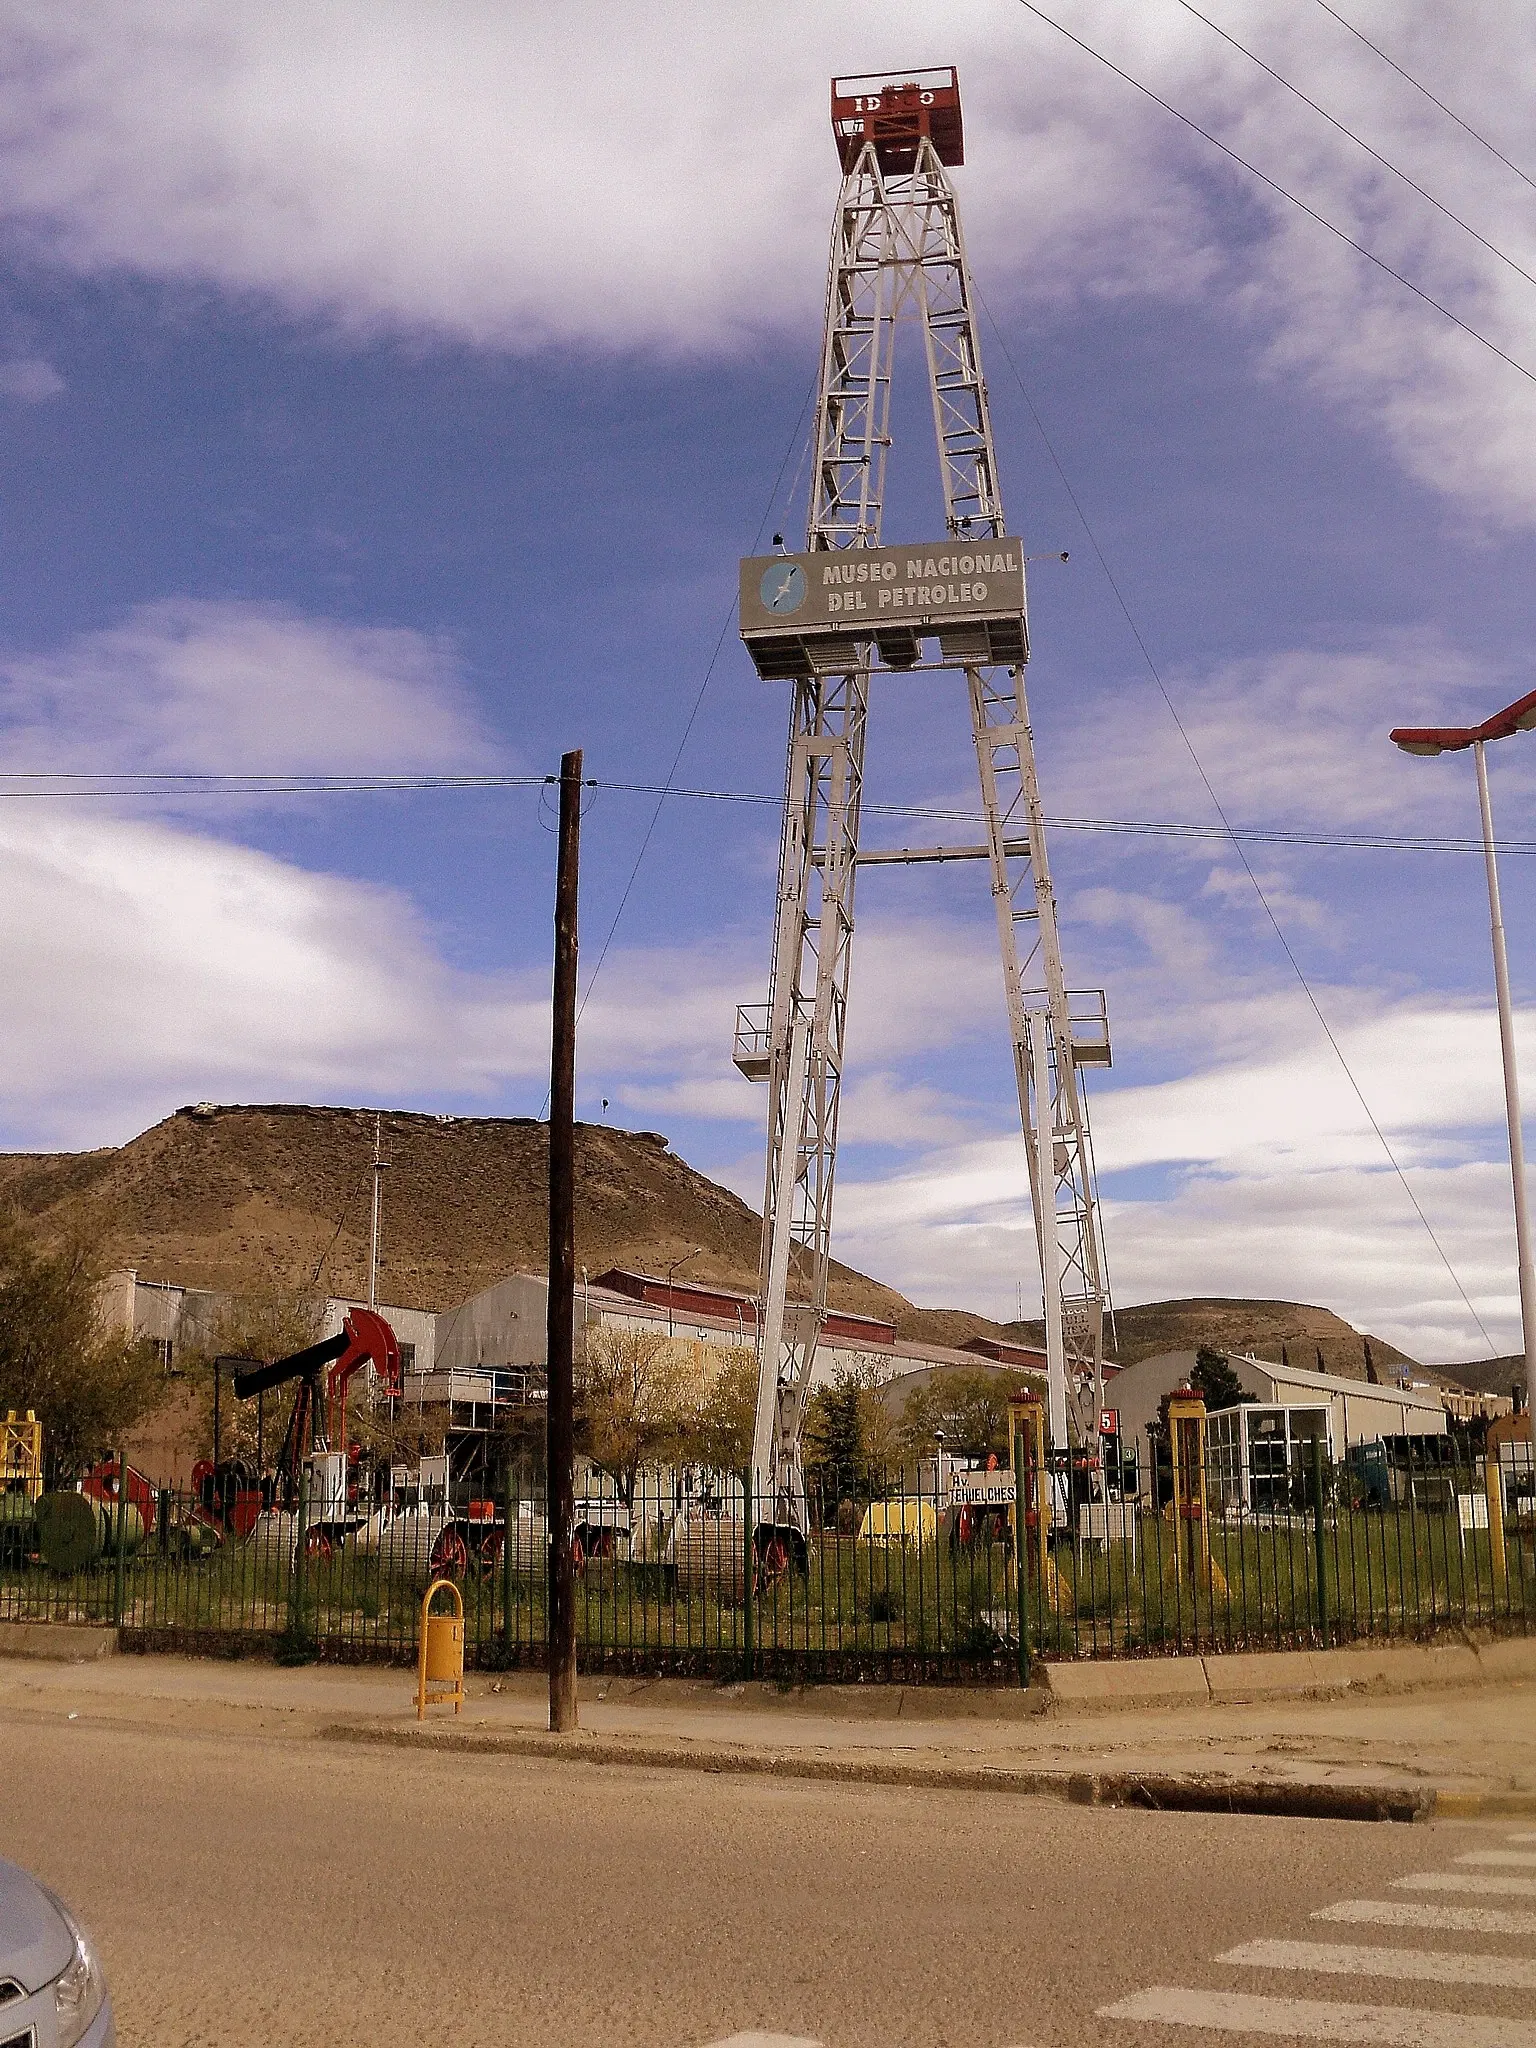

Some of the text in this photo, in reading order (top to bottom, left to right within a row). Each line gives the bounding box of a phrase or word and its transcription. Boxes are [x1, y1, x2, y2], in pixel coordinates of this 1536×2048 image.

[822, 553, 1018, 585] MUSEO NACIONAL
[828, 582, 988, 612] DEL PETROLEO
[1101, 1413, 1111, 1429] 5
[952, 1475, 970, 1487] Av.
[949, 1487, 1015, 1502] TEHUELCHES
